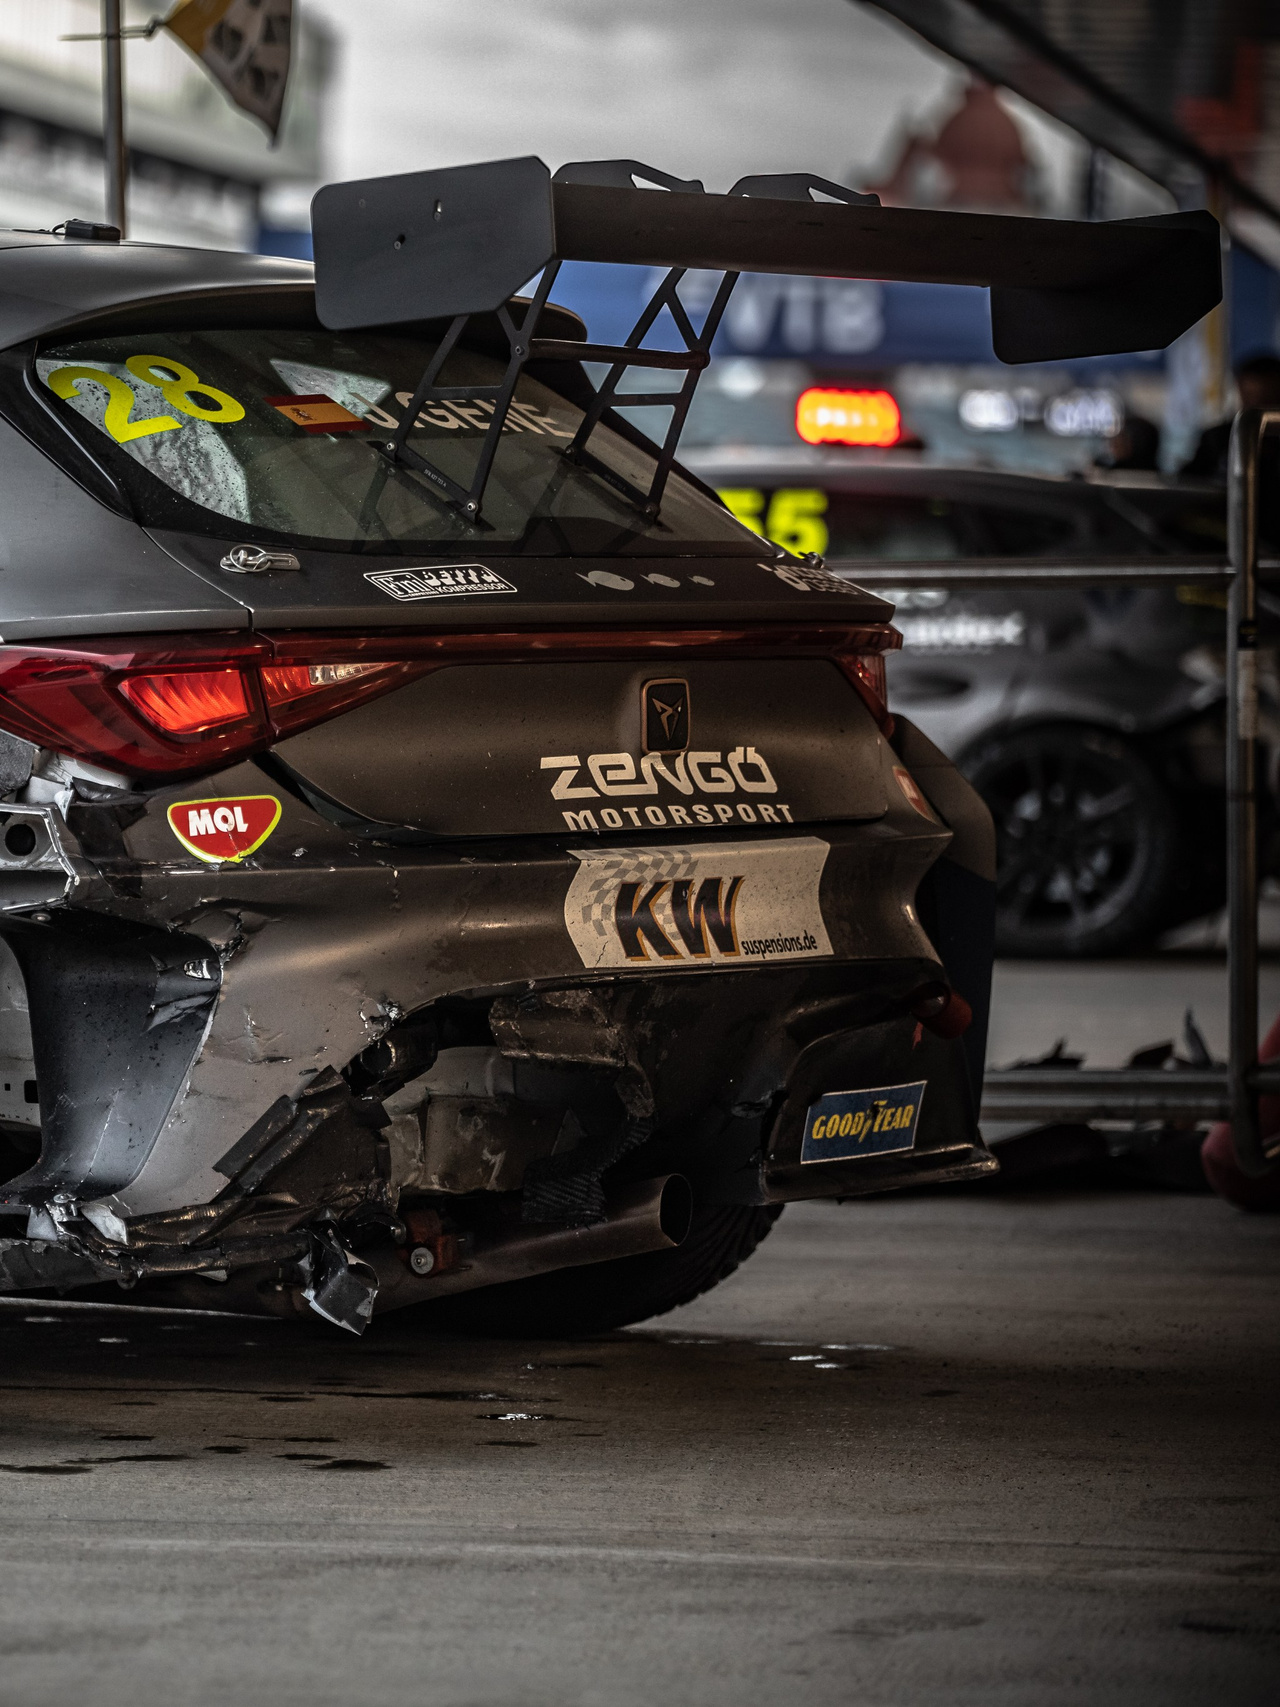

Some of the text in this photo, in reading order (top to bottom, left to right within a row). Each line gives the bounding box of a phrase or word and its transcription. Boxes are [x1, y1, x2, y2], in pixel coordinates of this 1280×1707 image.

[46, 355, 246, 443] 28
[187, 806, 248, 836] MOL
[562, 803, 794, 831] MOTORSPORT
[616, 875, 743, 961] KW
[741, 930, 818, 959] suspensions.de
[812, 1101, 914, 1141] GOODYEAR
